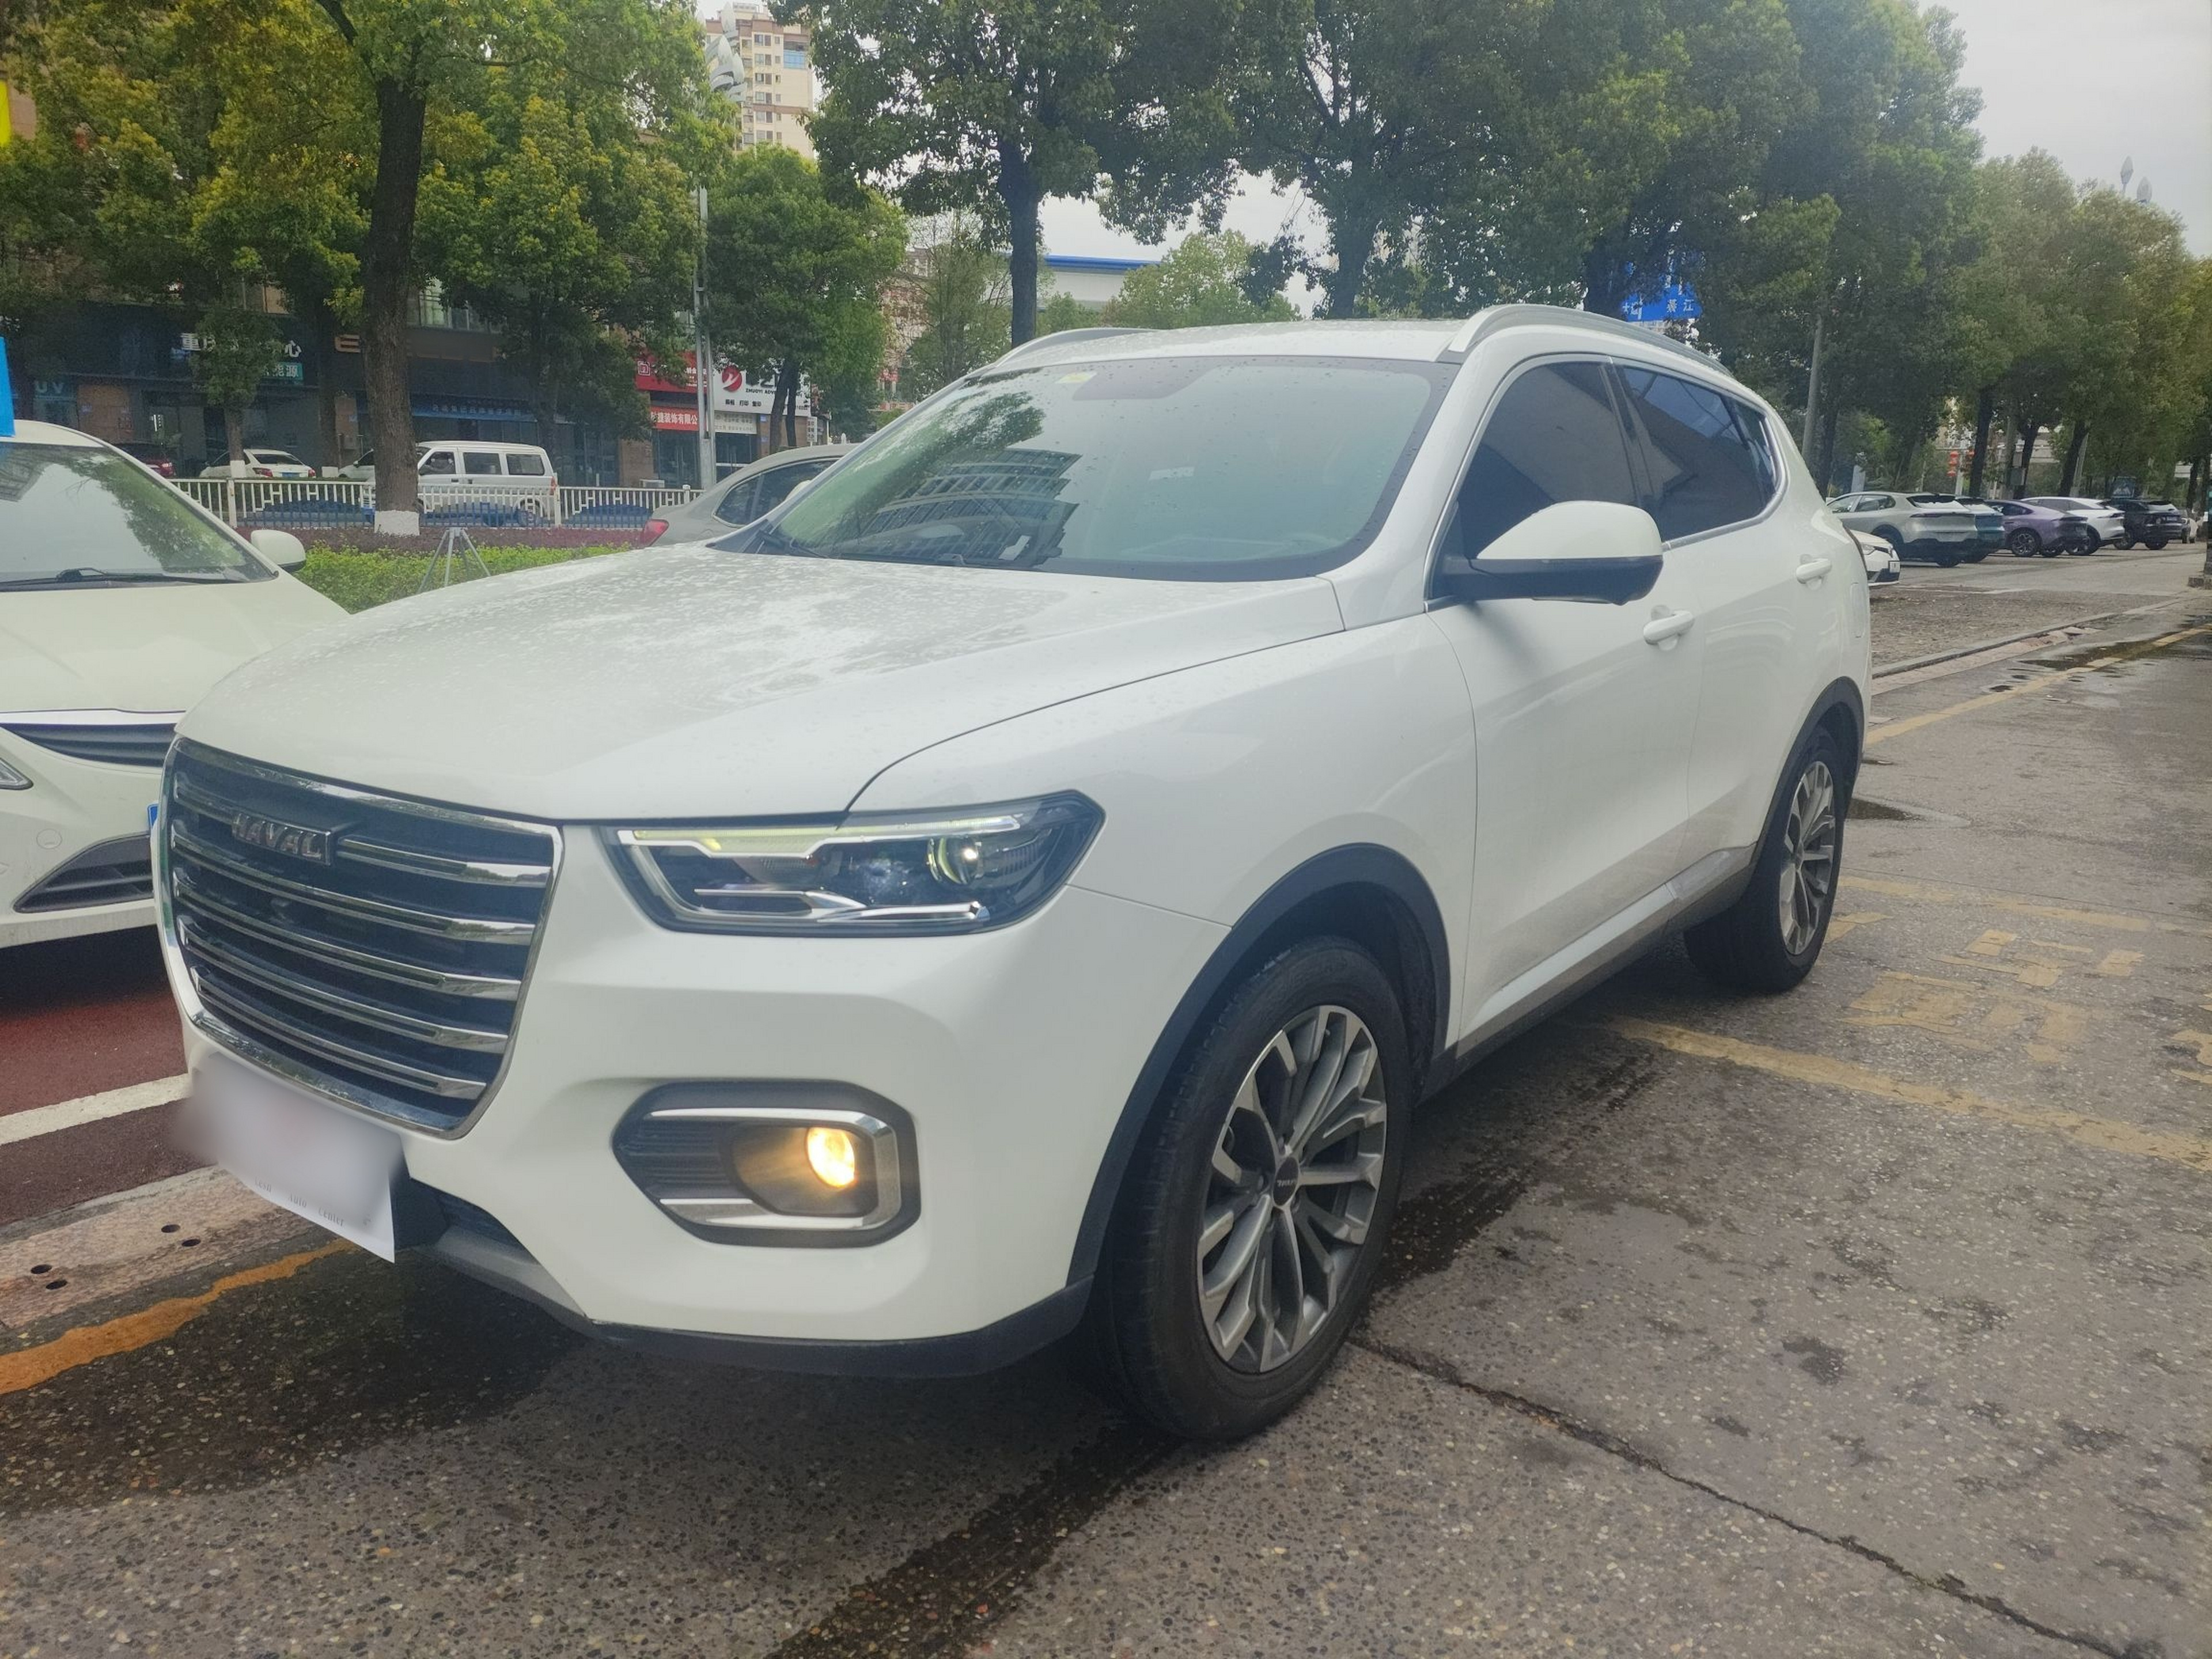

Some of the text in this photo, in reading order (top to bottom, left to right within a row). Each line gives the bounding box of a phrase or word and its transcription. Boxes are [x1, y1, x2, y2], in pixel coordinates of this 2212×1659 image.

[231, 812, 323, 860] HAVAL
[288, 1193, 307, 1208] Auto
[318, 1206, 345, 1227] Center
